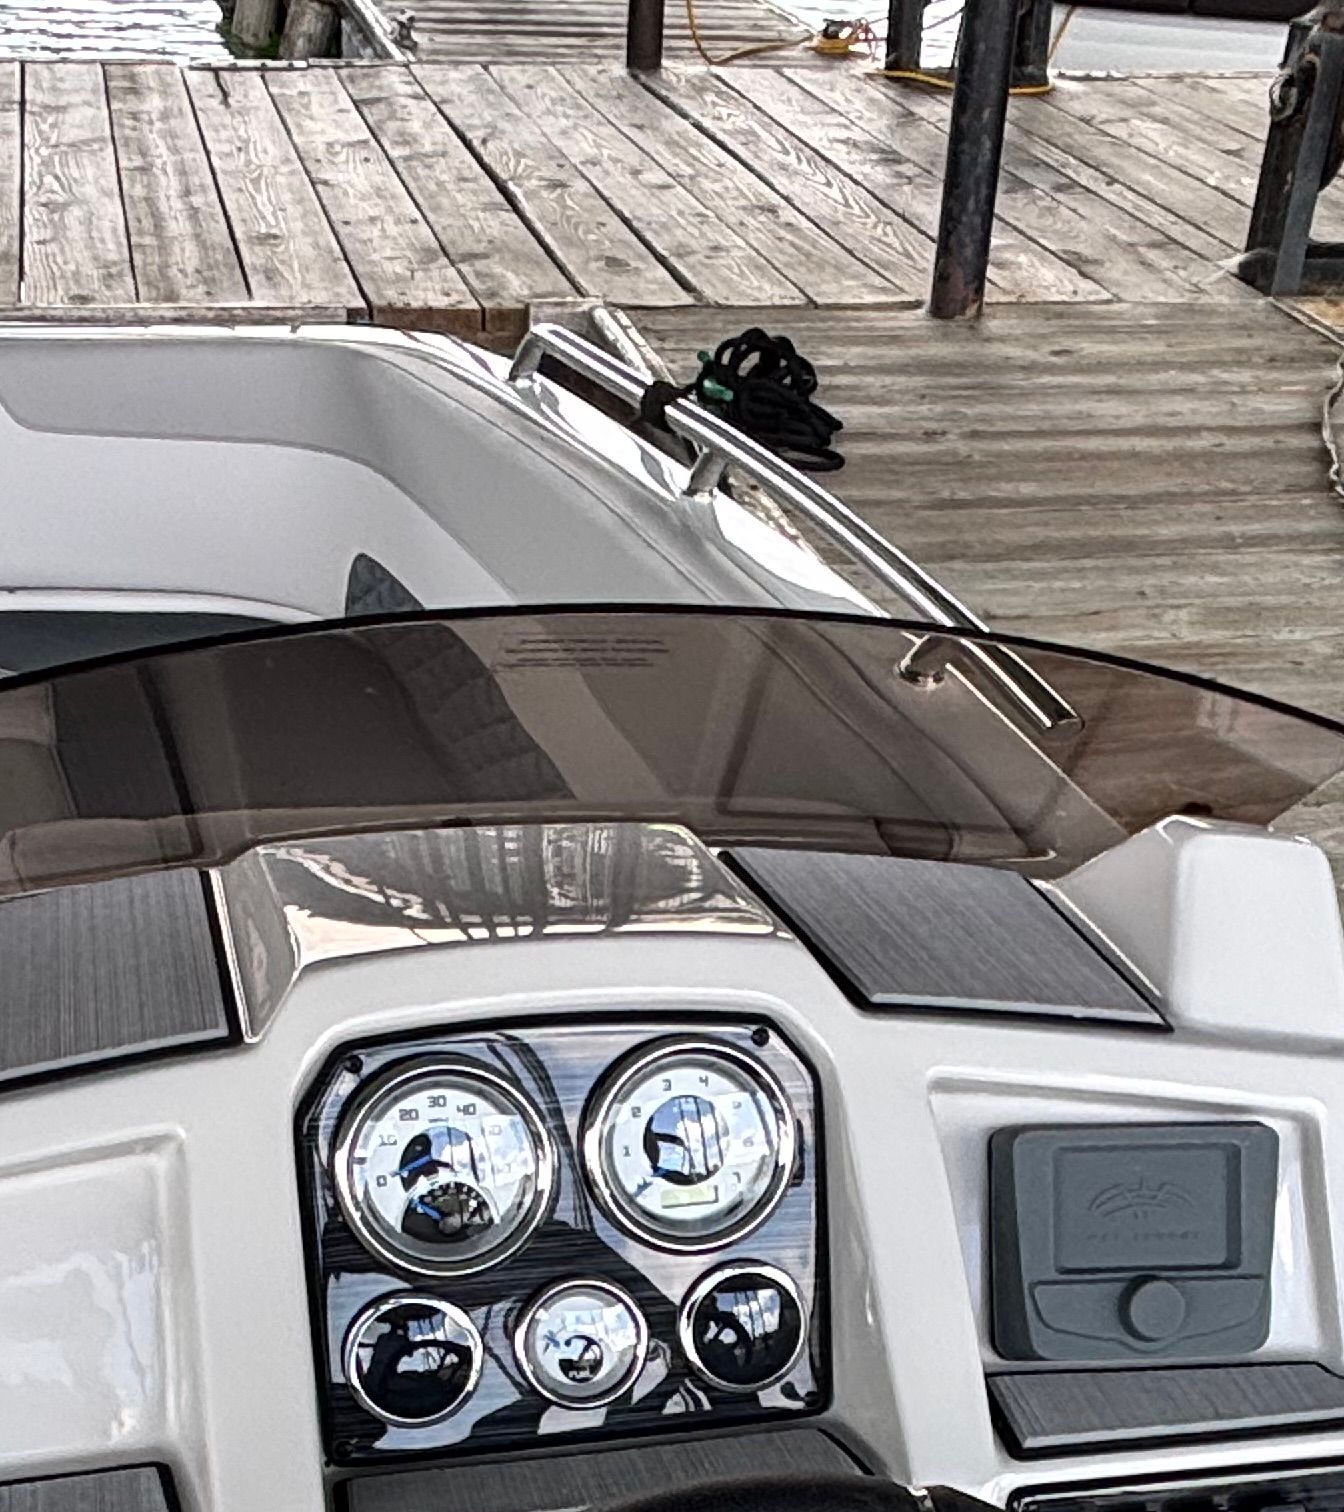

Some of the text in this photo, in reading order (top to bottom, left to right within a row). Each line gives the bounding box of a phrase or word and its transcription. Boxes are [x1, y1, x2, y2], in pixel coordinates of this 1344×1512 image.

[662, 1079, 672, 1091] 3
[699, 1076, 709, 1087] 4
[427, 1095, 447, 1107] 30
[399, 1109, 419, 1121] 20
[456, 1103, 476, 1115] 40
[631, 1106, 641, 1118] 2
[378, 1134, 398, 1147] 10
[623, 1146, 631, 1157] 1
[376, 1175, 387, 1187] 0
